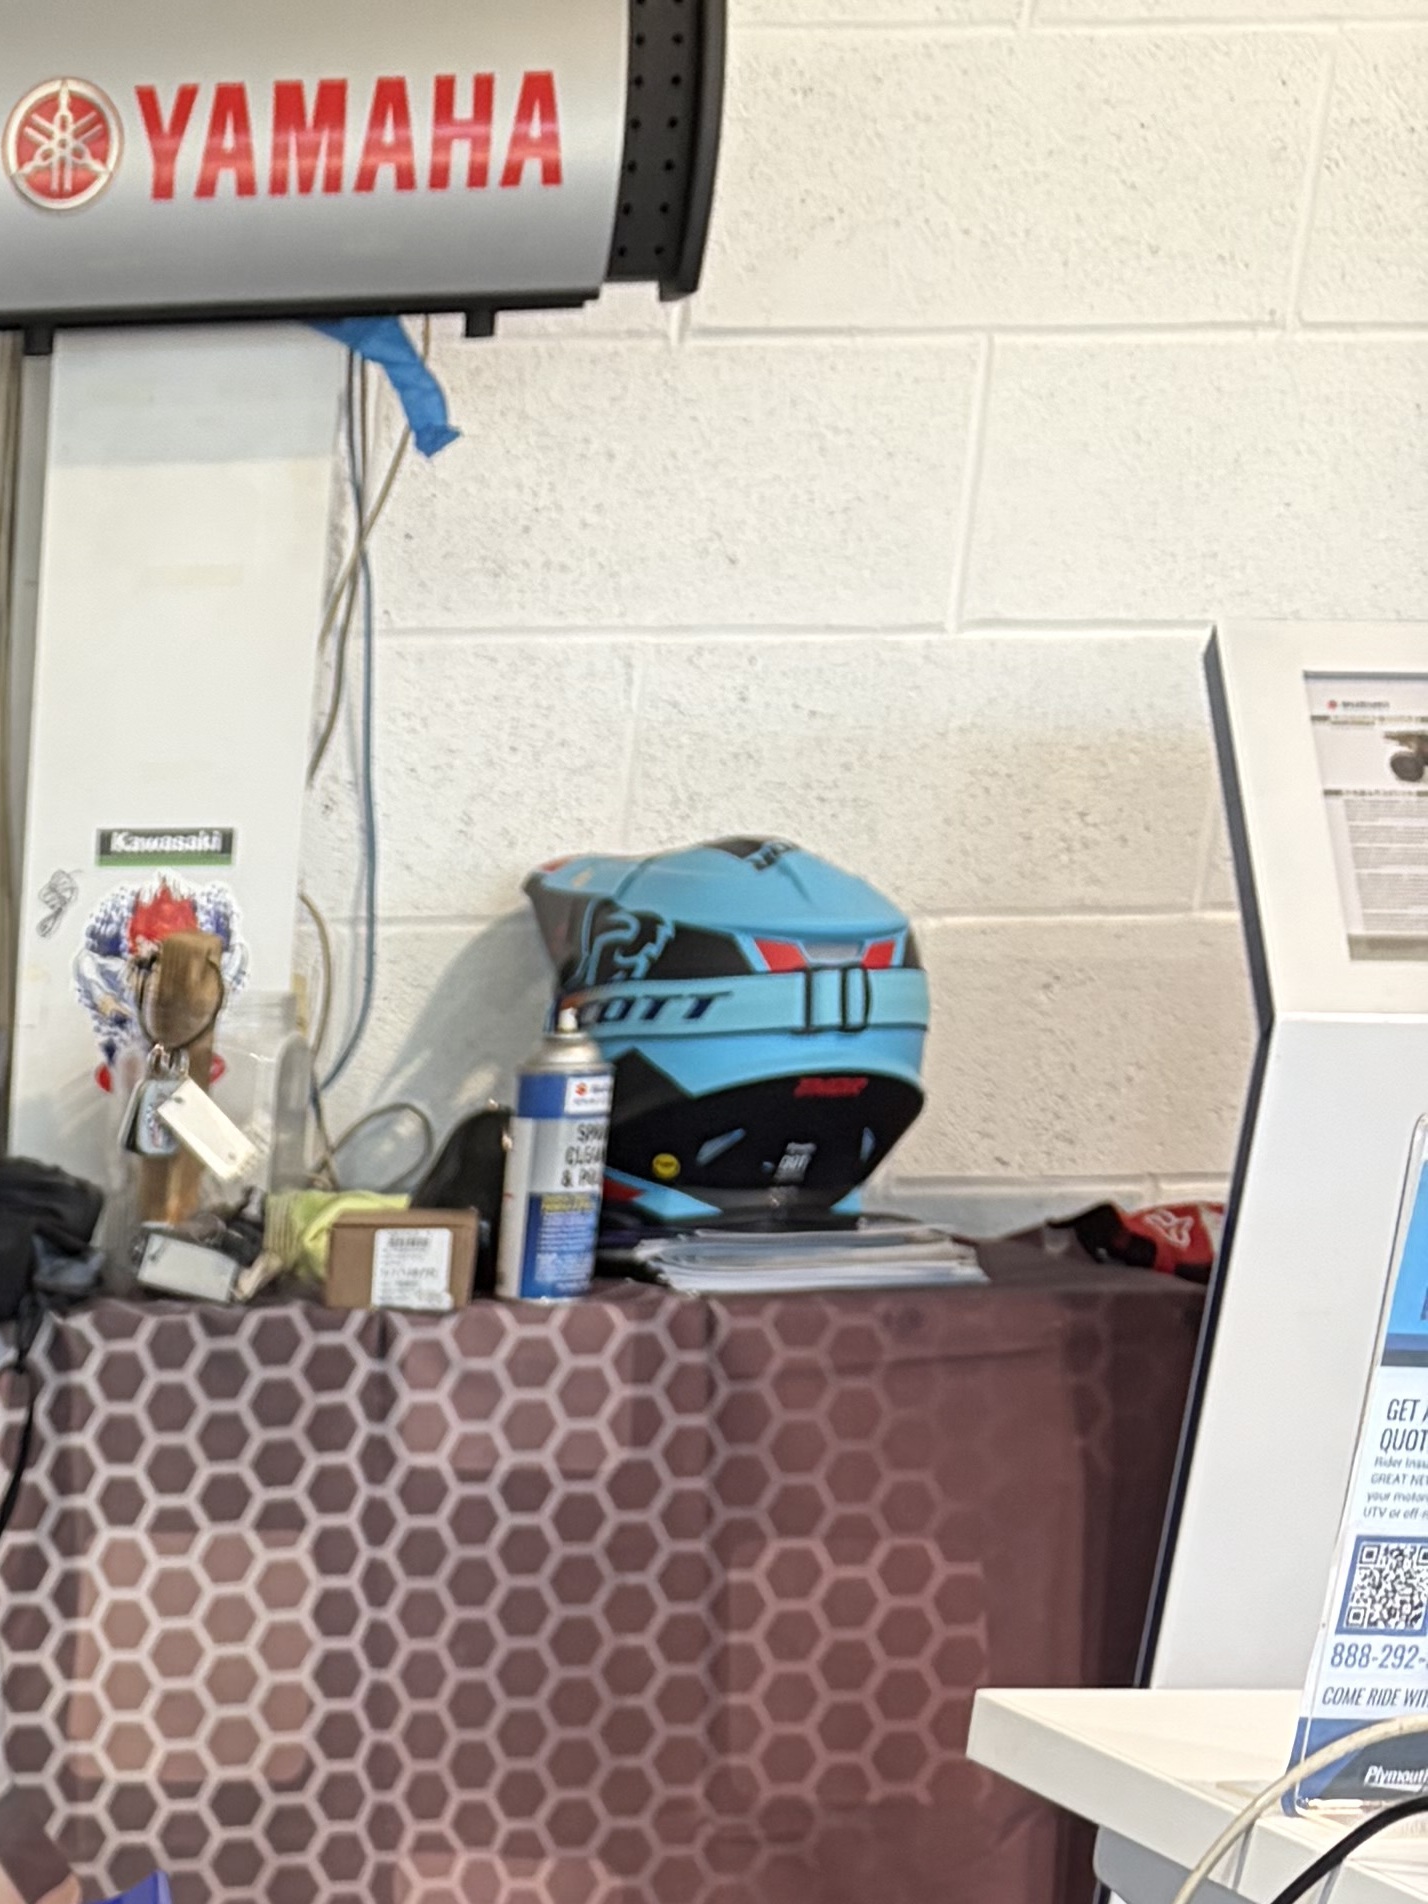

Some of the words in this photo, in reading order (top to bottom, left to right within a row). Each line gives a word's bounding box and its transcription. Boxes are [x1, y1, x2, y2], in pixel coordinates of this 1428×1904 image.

[135, 70, 562, 201] YAMAHA
[110, 830, 223, 853] Kawasaki
[1386, 1398, 1421, 1422] GET
[1370, 1473, 1407, 1485] GREAT
[1367, 1492, 1391, 1503] your
[1363, 1507, 1387, 1519] UTV
[1389, 1509, 1401, 1519] or
[1330, 1642, 1428, 1670] 888-292-
[1322, 1686, 1366, 1706] COME
[1367, 1687, 1402, 1707] RIDE
